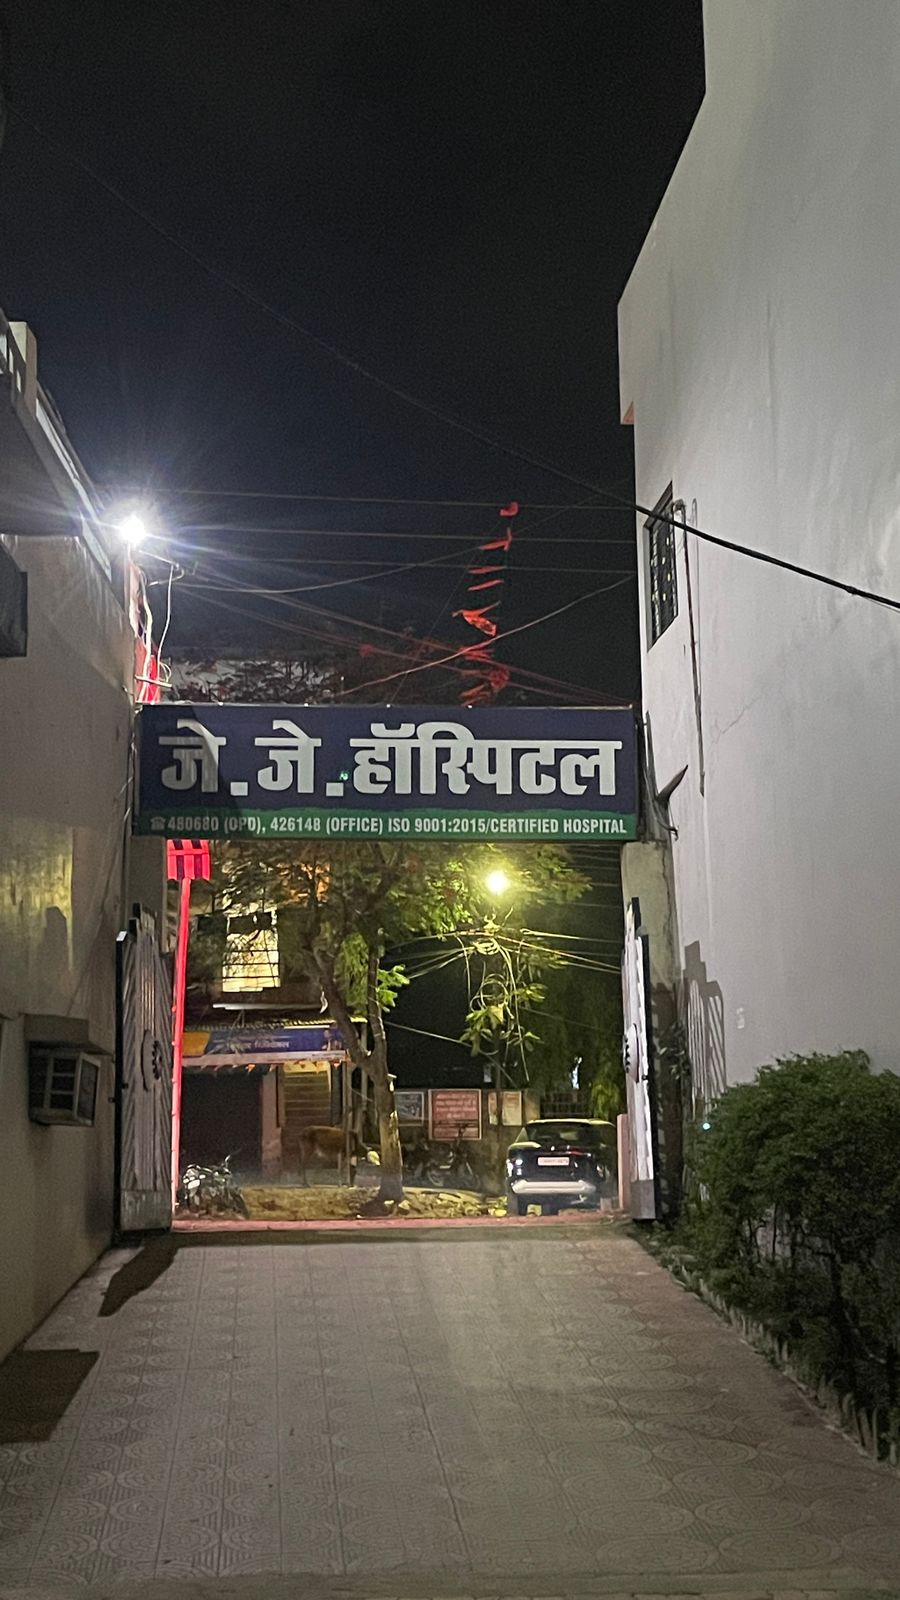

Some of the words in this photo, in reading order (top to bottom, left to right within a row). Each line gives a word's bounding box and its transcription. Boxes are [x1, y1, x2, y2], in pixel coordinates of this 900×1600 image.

[224, 816, 266, 834] (OPD),
[271, 817, 321, 832] 426148
[326, 817, 383, 834] (OFFICE)
[388, 818, 410, 833] ISO
[563, 818, 627, 834] HOSPITAL
